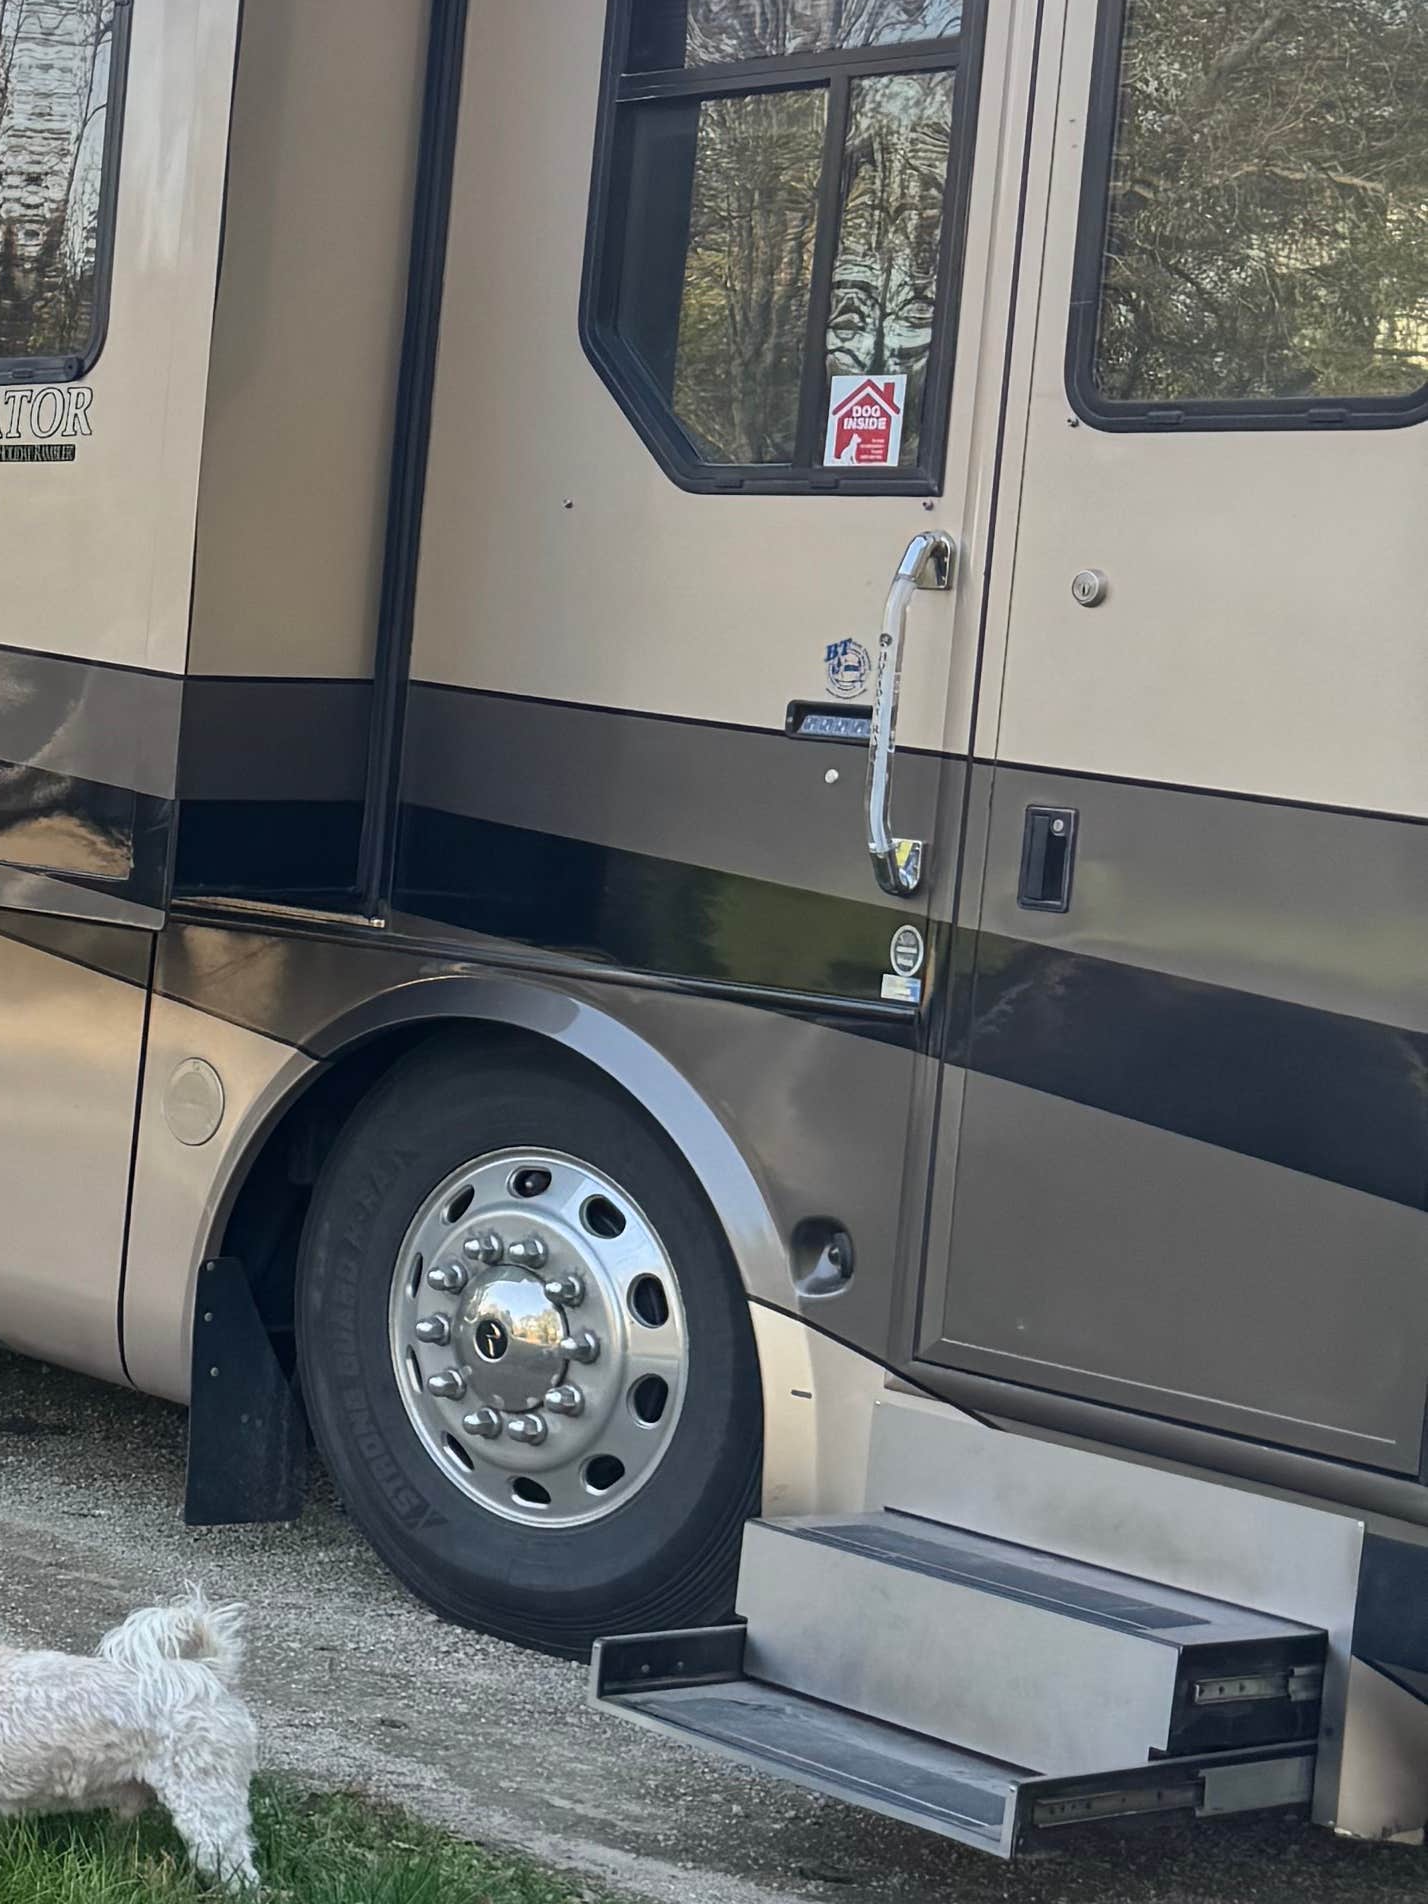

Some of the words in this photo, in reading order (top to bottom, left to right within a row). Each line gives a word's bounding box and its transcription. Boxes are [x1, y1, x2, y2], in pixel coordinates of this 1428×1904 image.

[852, 405, 881, 417] DOG
[843, 417, 887, 430] INSIDE
[825, 638, 852, 662] BT
